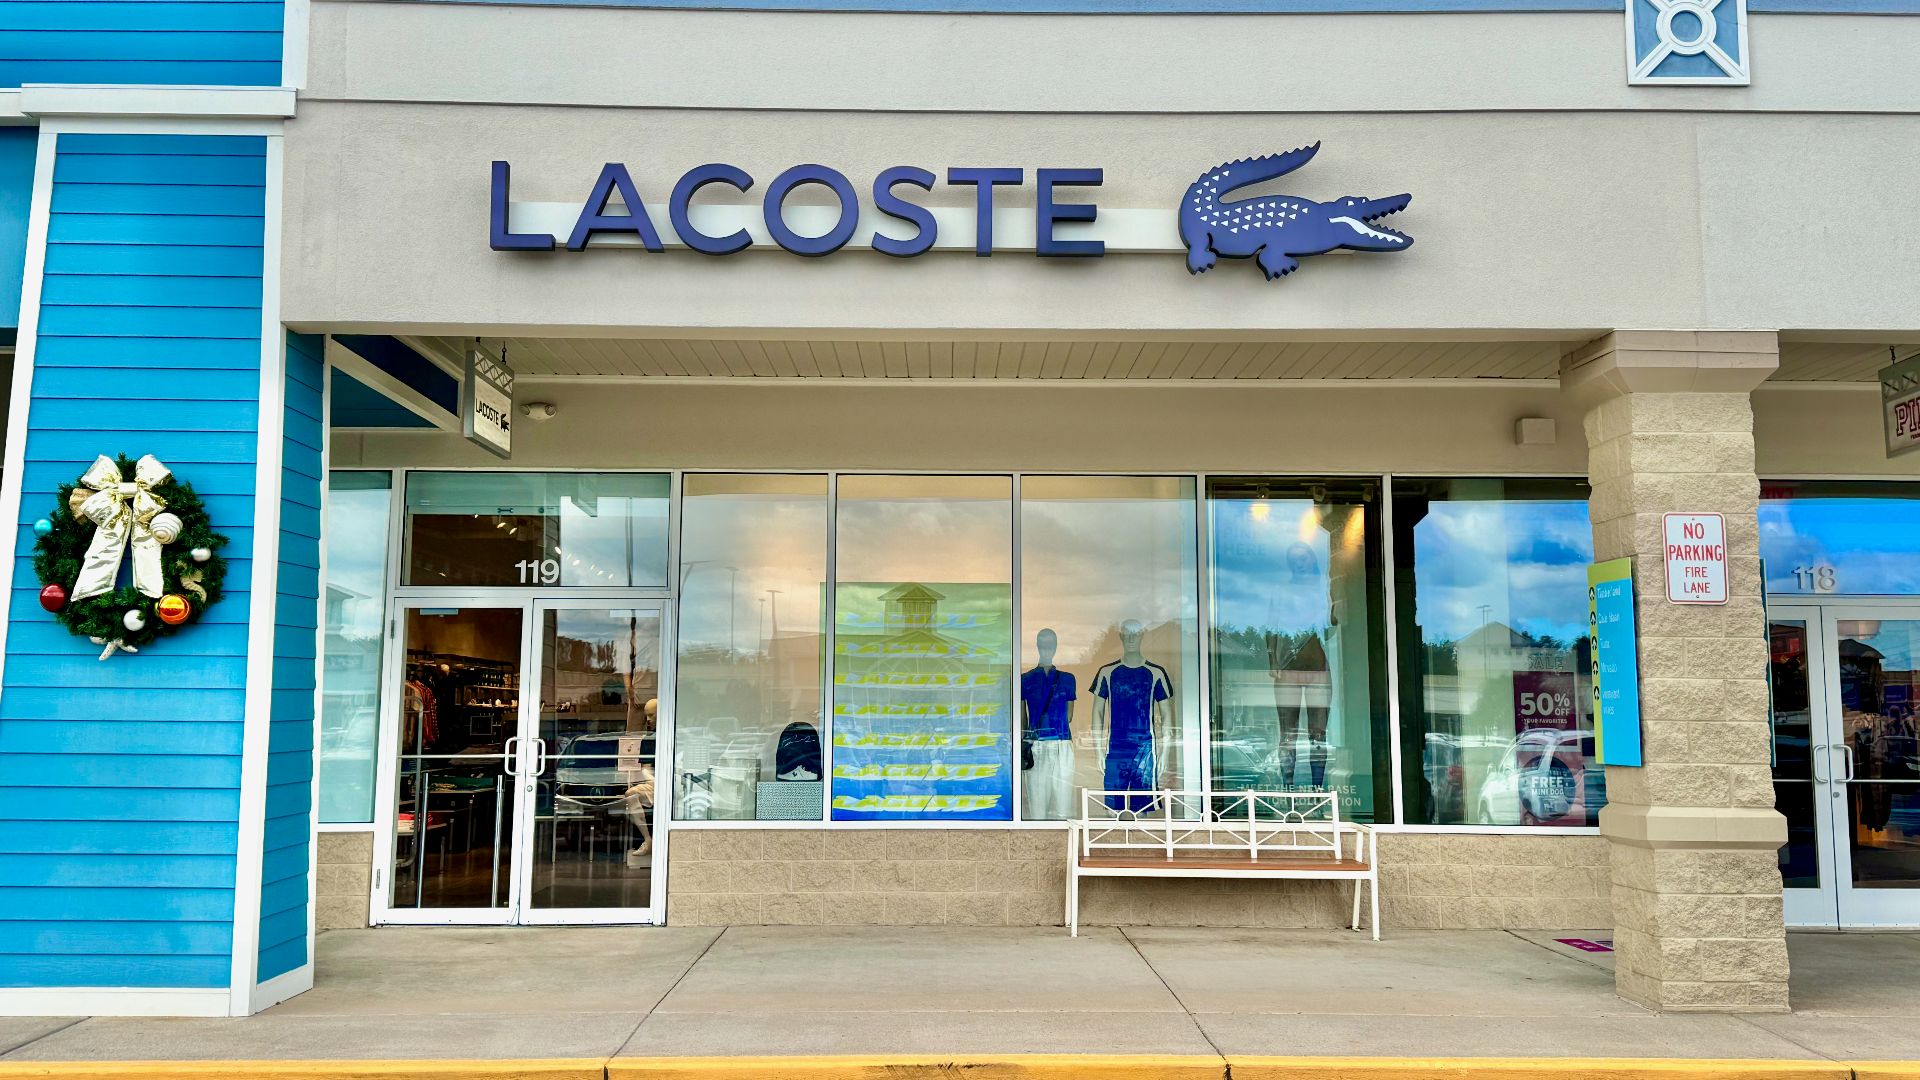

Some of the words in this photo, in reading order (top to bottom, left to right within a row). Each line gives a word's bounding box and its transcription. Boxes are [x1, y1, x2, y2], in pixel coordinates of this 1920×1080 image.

[489, 160, 1106, 258] LACOSTE
[475, 397, 500, 426] LACOSTE
[1683, 522, 1705, 539] NO
[1668, 544, 1723, 561] PARKING
[514, 559, 560, 584] 119
[1685, 566, 1709, 578] FIRE
[1791, 566, 1836, 591] 118
[1683, 582, 1711, 594] LANE
[1520, 692, 1571, 716] 50%
[1554, 708, 1571, 717] OFF
[1273, 784, 1295, 793] THE
[1298, 784, 1324, 793] NEW
[1327, 785, 1357, 795] BASE
[1531, 776, 1564, 788] FREE
[1294, 797, 1361, 807] COLLECION
